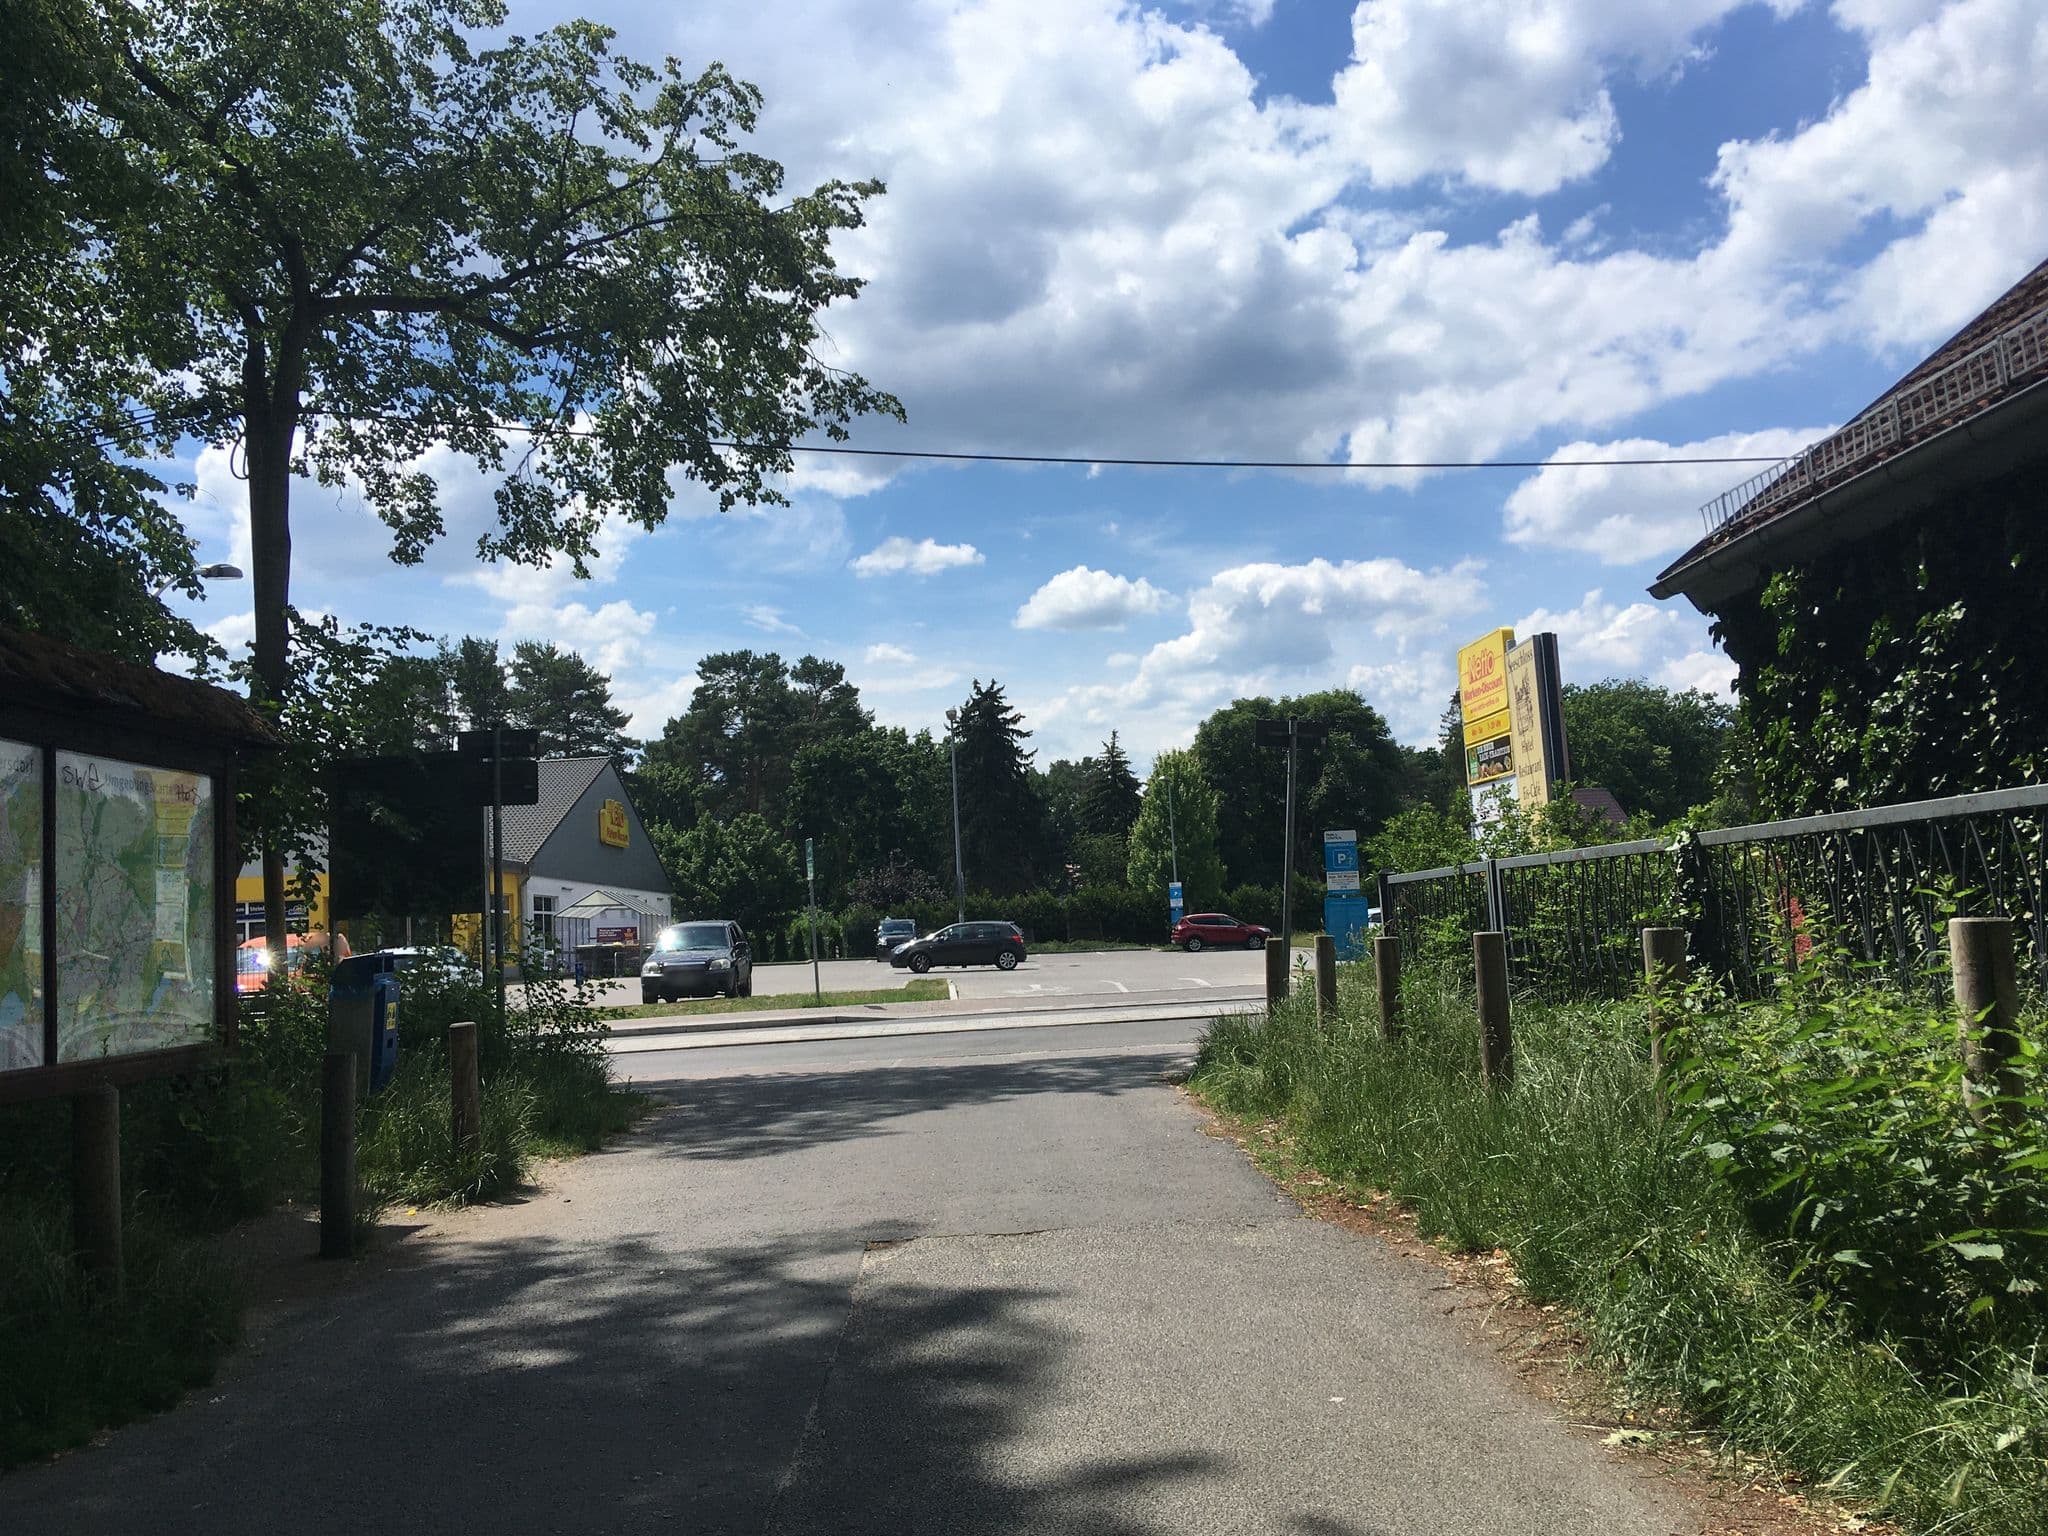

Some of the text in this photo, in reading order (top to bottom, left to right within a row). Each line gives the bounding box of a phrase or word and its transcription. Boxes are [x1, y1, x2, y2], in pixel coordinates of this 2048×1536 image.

[1468, 648, 1495, 684] Netto
[1518, 760, 1542, 777] Restaurant
[1338, 853, 1346, 864] P
